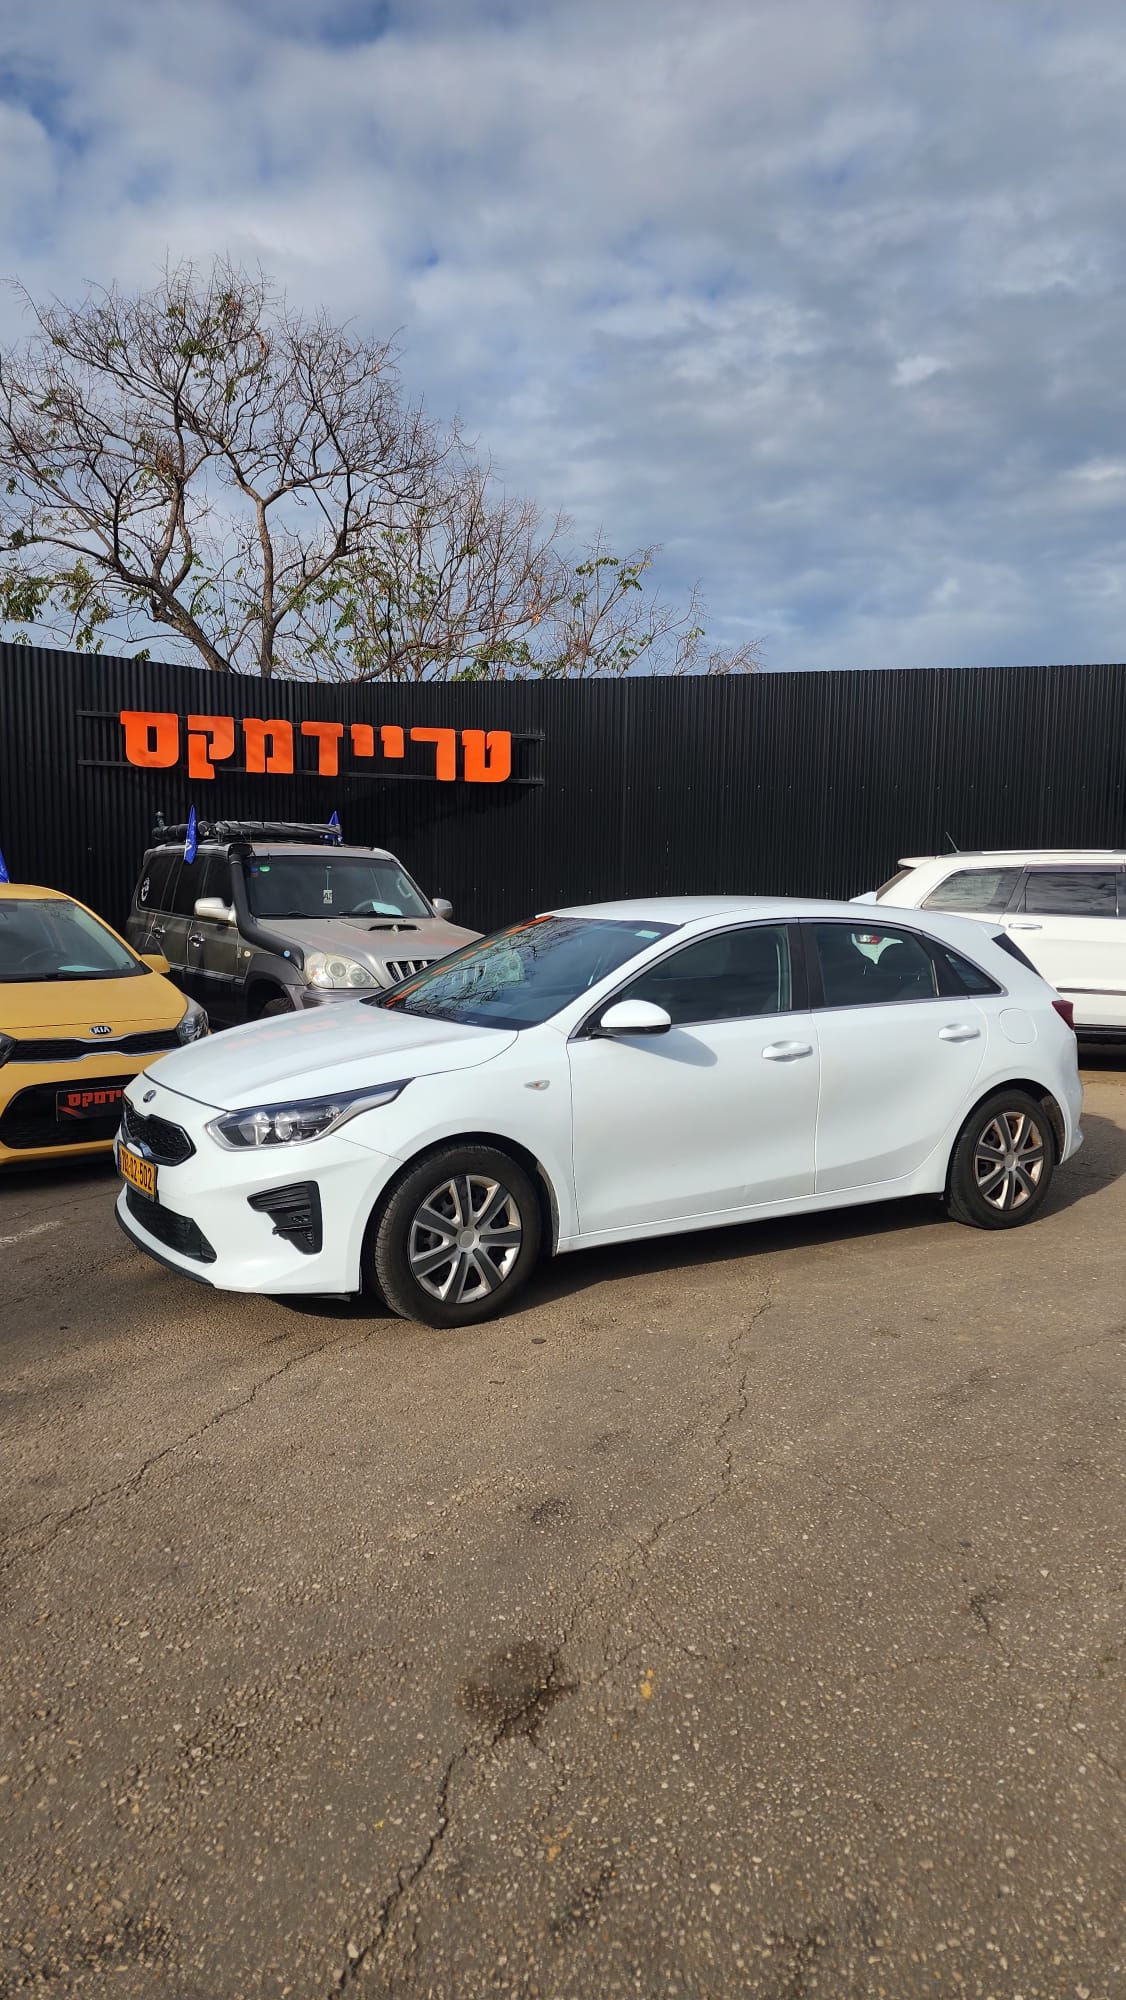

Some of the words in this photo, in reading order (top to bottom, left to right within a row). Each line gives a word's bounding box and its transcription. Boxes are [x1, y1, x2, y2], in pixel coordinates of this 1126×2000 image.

[120, 710, 512, 783] טריידמקס
[93, 1026, 110, 1034] KIA
[67, 1089, 122, 1108] ידמקס
